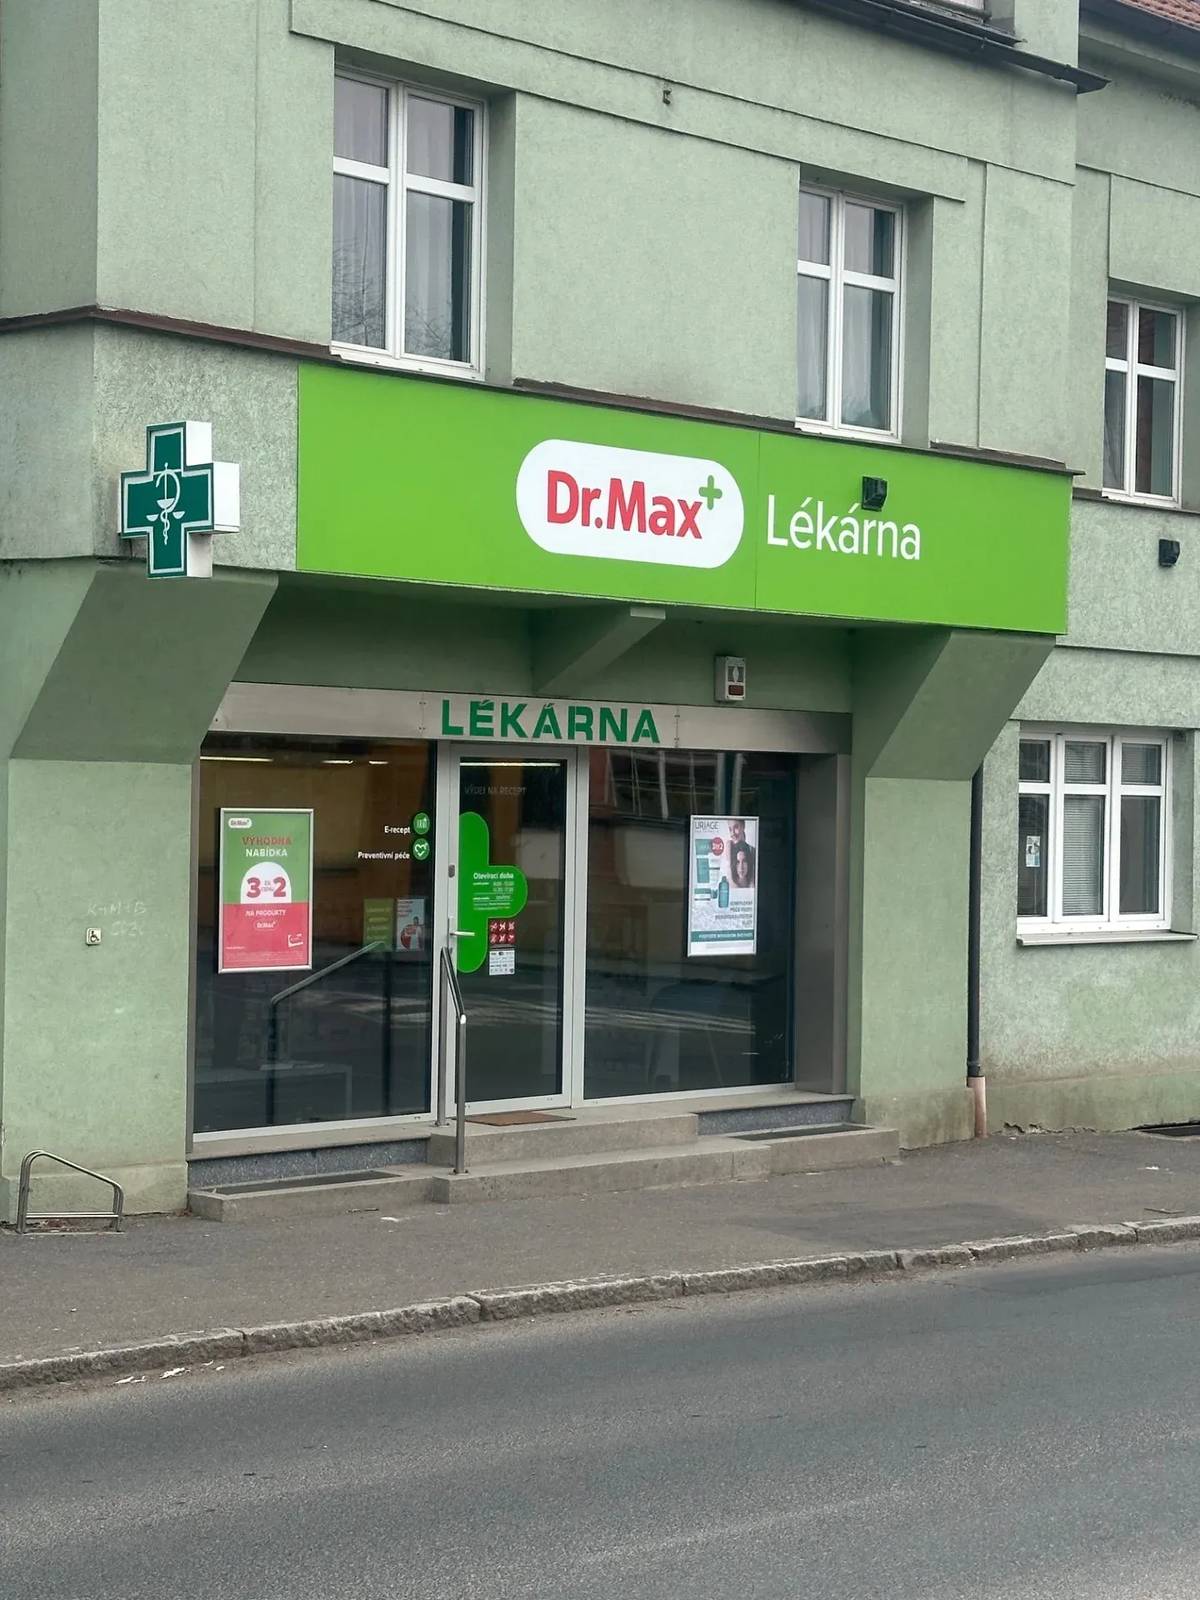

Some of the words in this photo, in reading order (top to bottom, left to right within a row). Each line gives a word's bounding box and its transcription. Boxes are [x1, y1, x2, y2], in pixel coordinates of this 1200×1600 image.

[767, 494, 921, 561] Lékárna
[442, 699, 661, 744] LÉKÁRNA
[384, 825, 411, 835] E-recept
[241, 832, 292, 846] VÝHODNÁ
[245, 846, 288, 857] NABÍDKA
[357, 850, 393, 860] Preventivní
[394, 851, 410, 861] péče
[499, 871, 514, 880] doba
[247, 877, 261, 898] 3
[273, 876, 287, 897] 2
